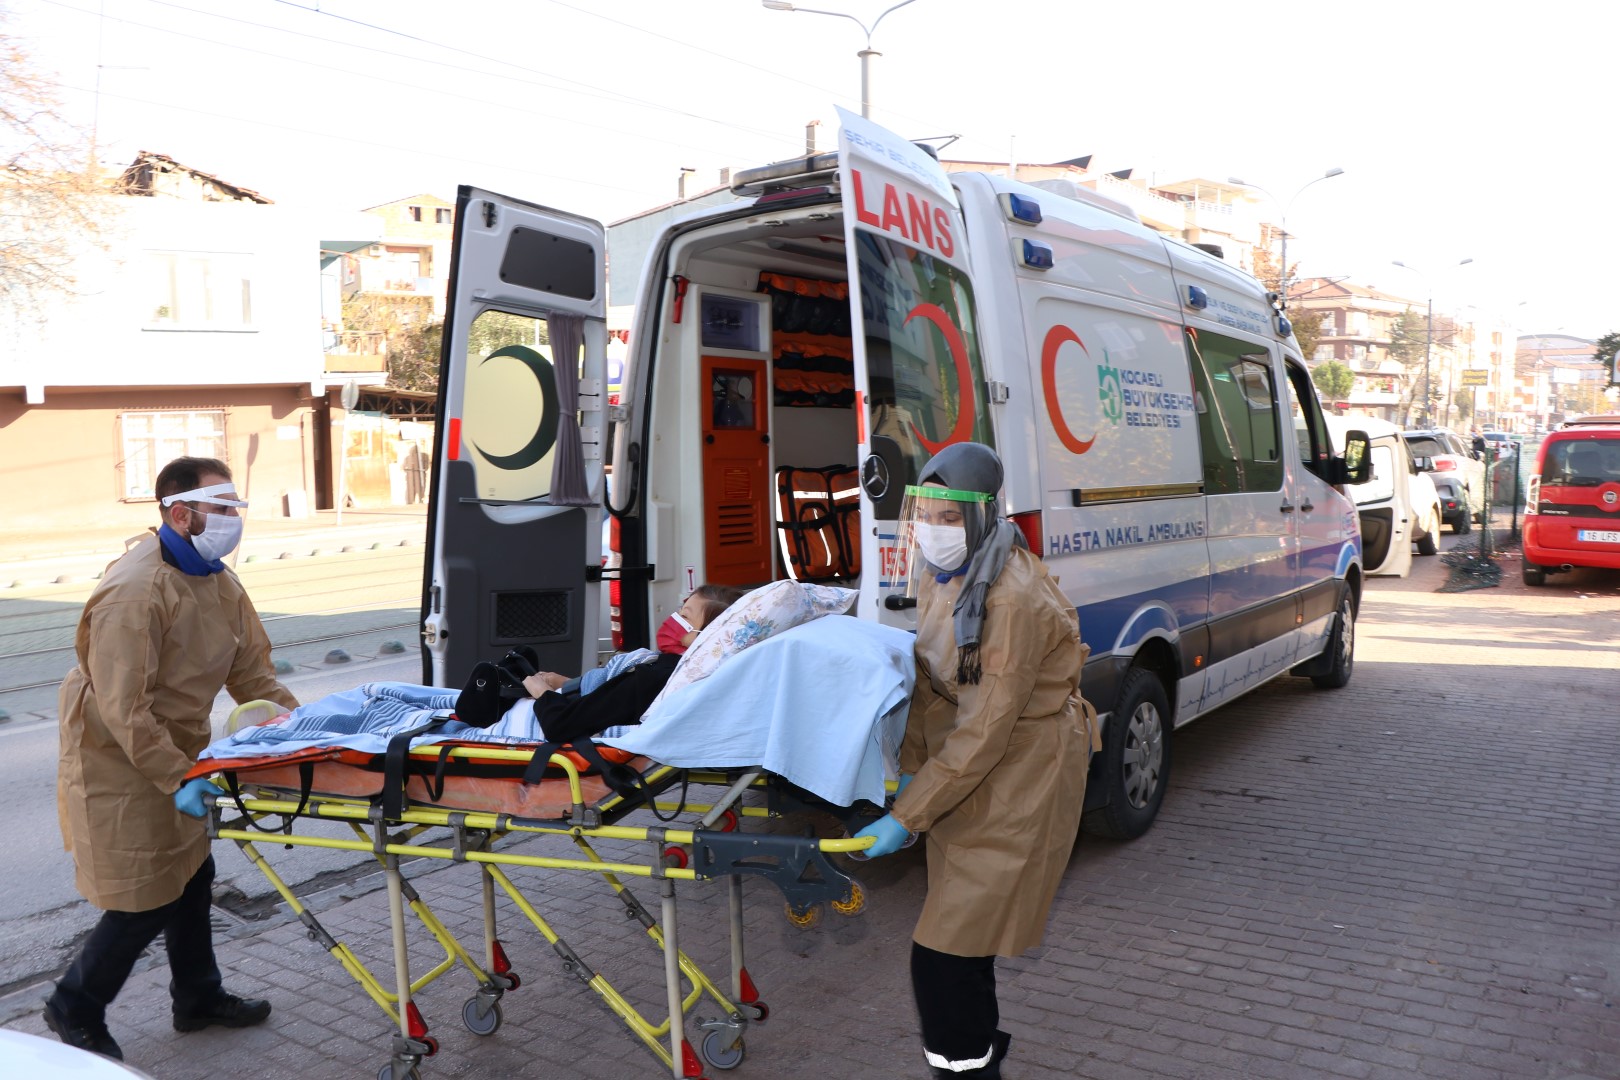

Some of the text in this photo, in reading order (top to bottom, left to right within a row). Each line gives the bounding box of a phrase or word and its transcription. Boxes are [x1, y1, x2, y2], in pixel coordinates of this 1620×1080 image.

[851, 169, 954, 258] LANS
[1050, 530, 1100, 554] HASTA
[879, 547, 908, 577] 153
